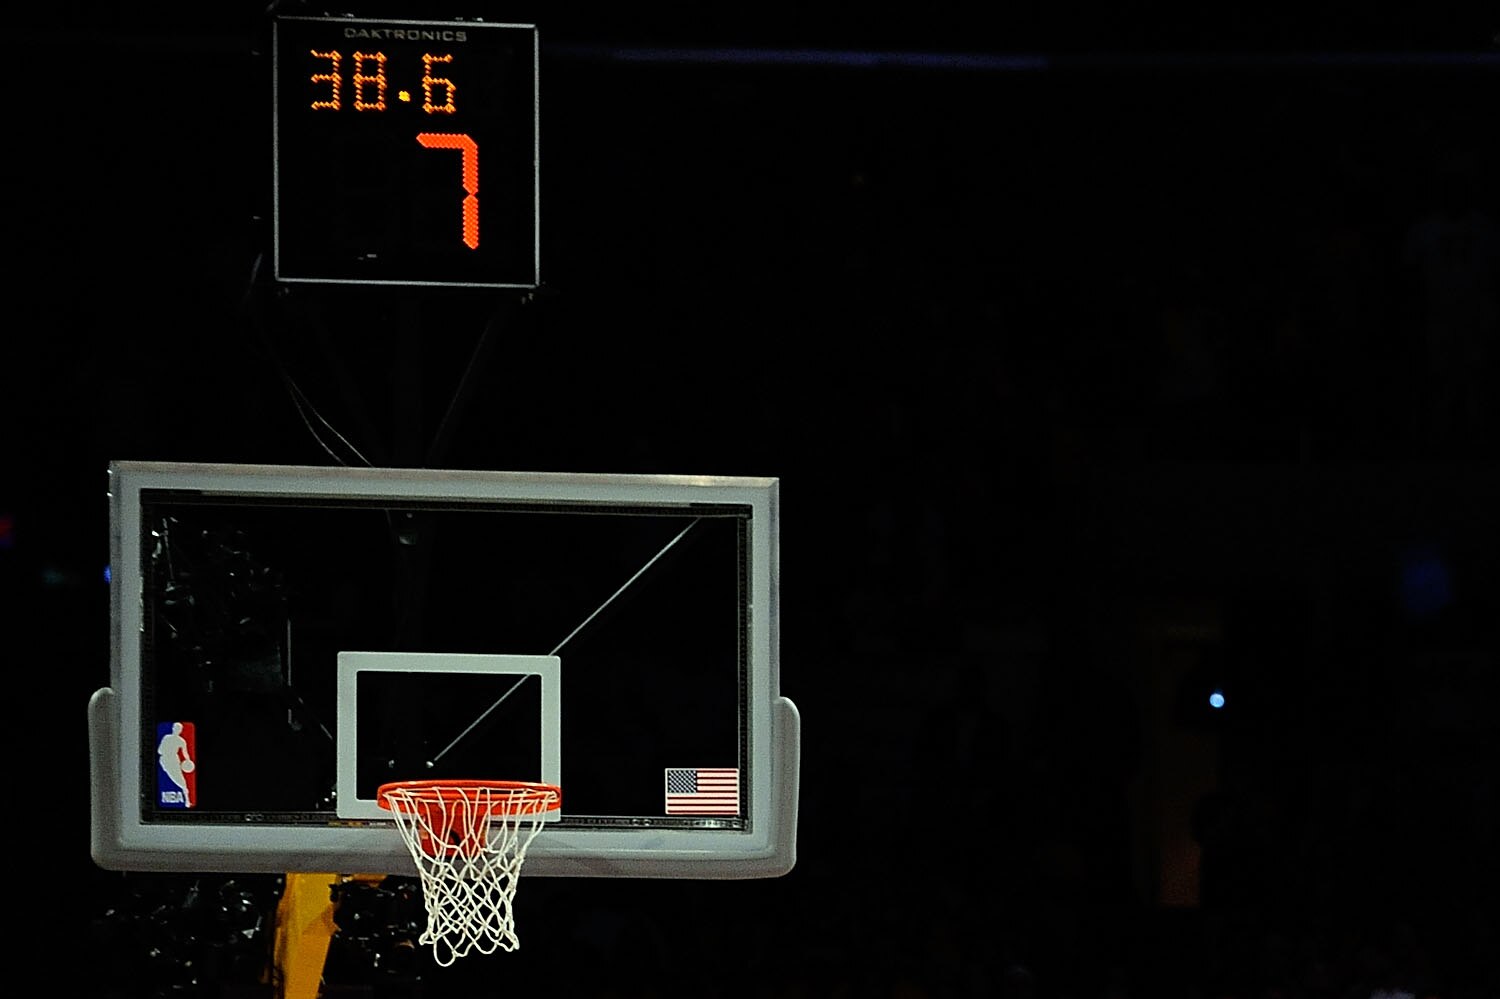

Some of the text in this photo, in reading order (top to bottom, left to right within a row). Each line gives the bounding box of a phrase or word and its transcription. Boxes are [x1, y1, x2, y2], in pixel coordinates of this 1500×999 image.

[344, 27, 467, 42] DAKTRONICS
[310, 49, 456, 113] 38.6
[416, 132, 479, 250] 7
[161, 791, 184, 803] NBA
